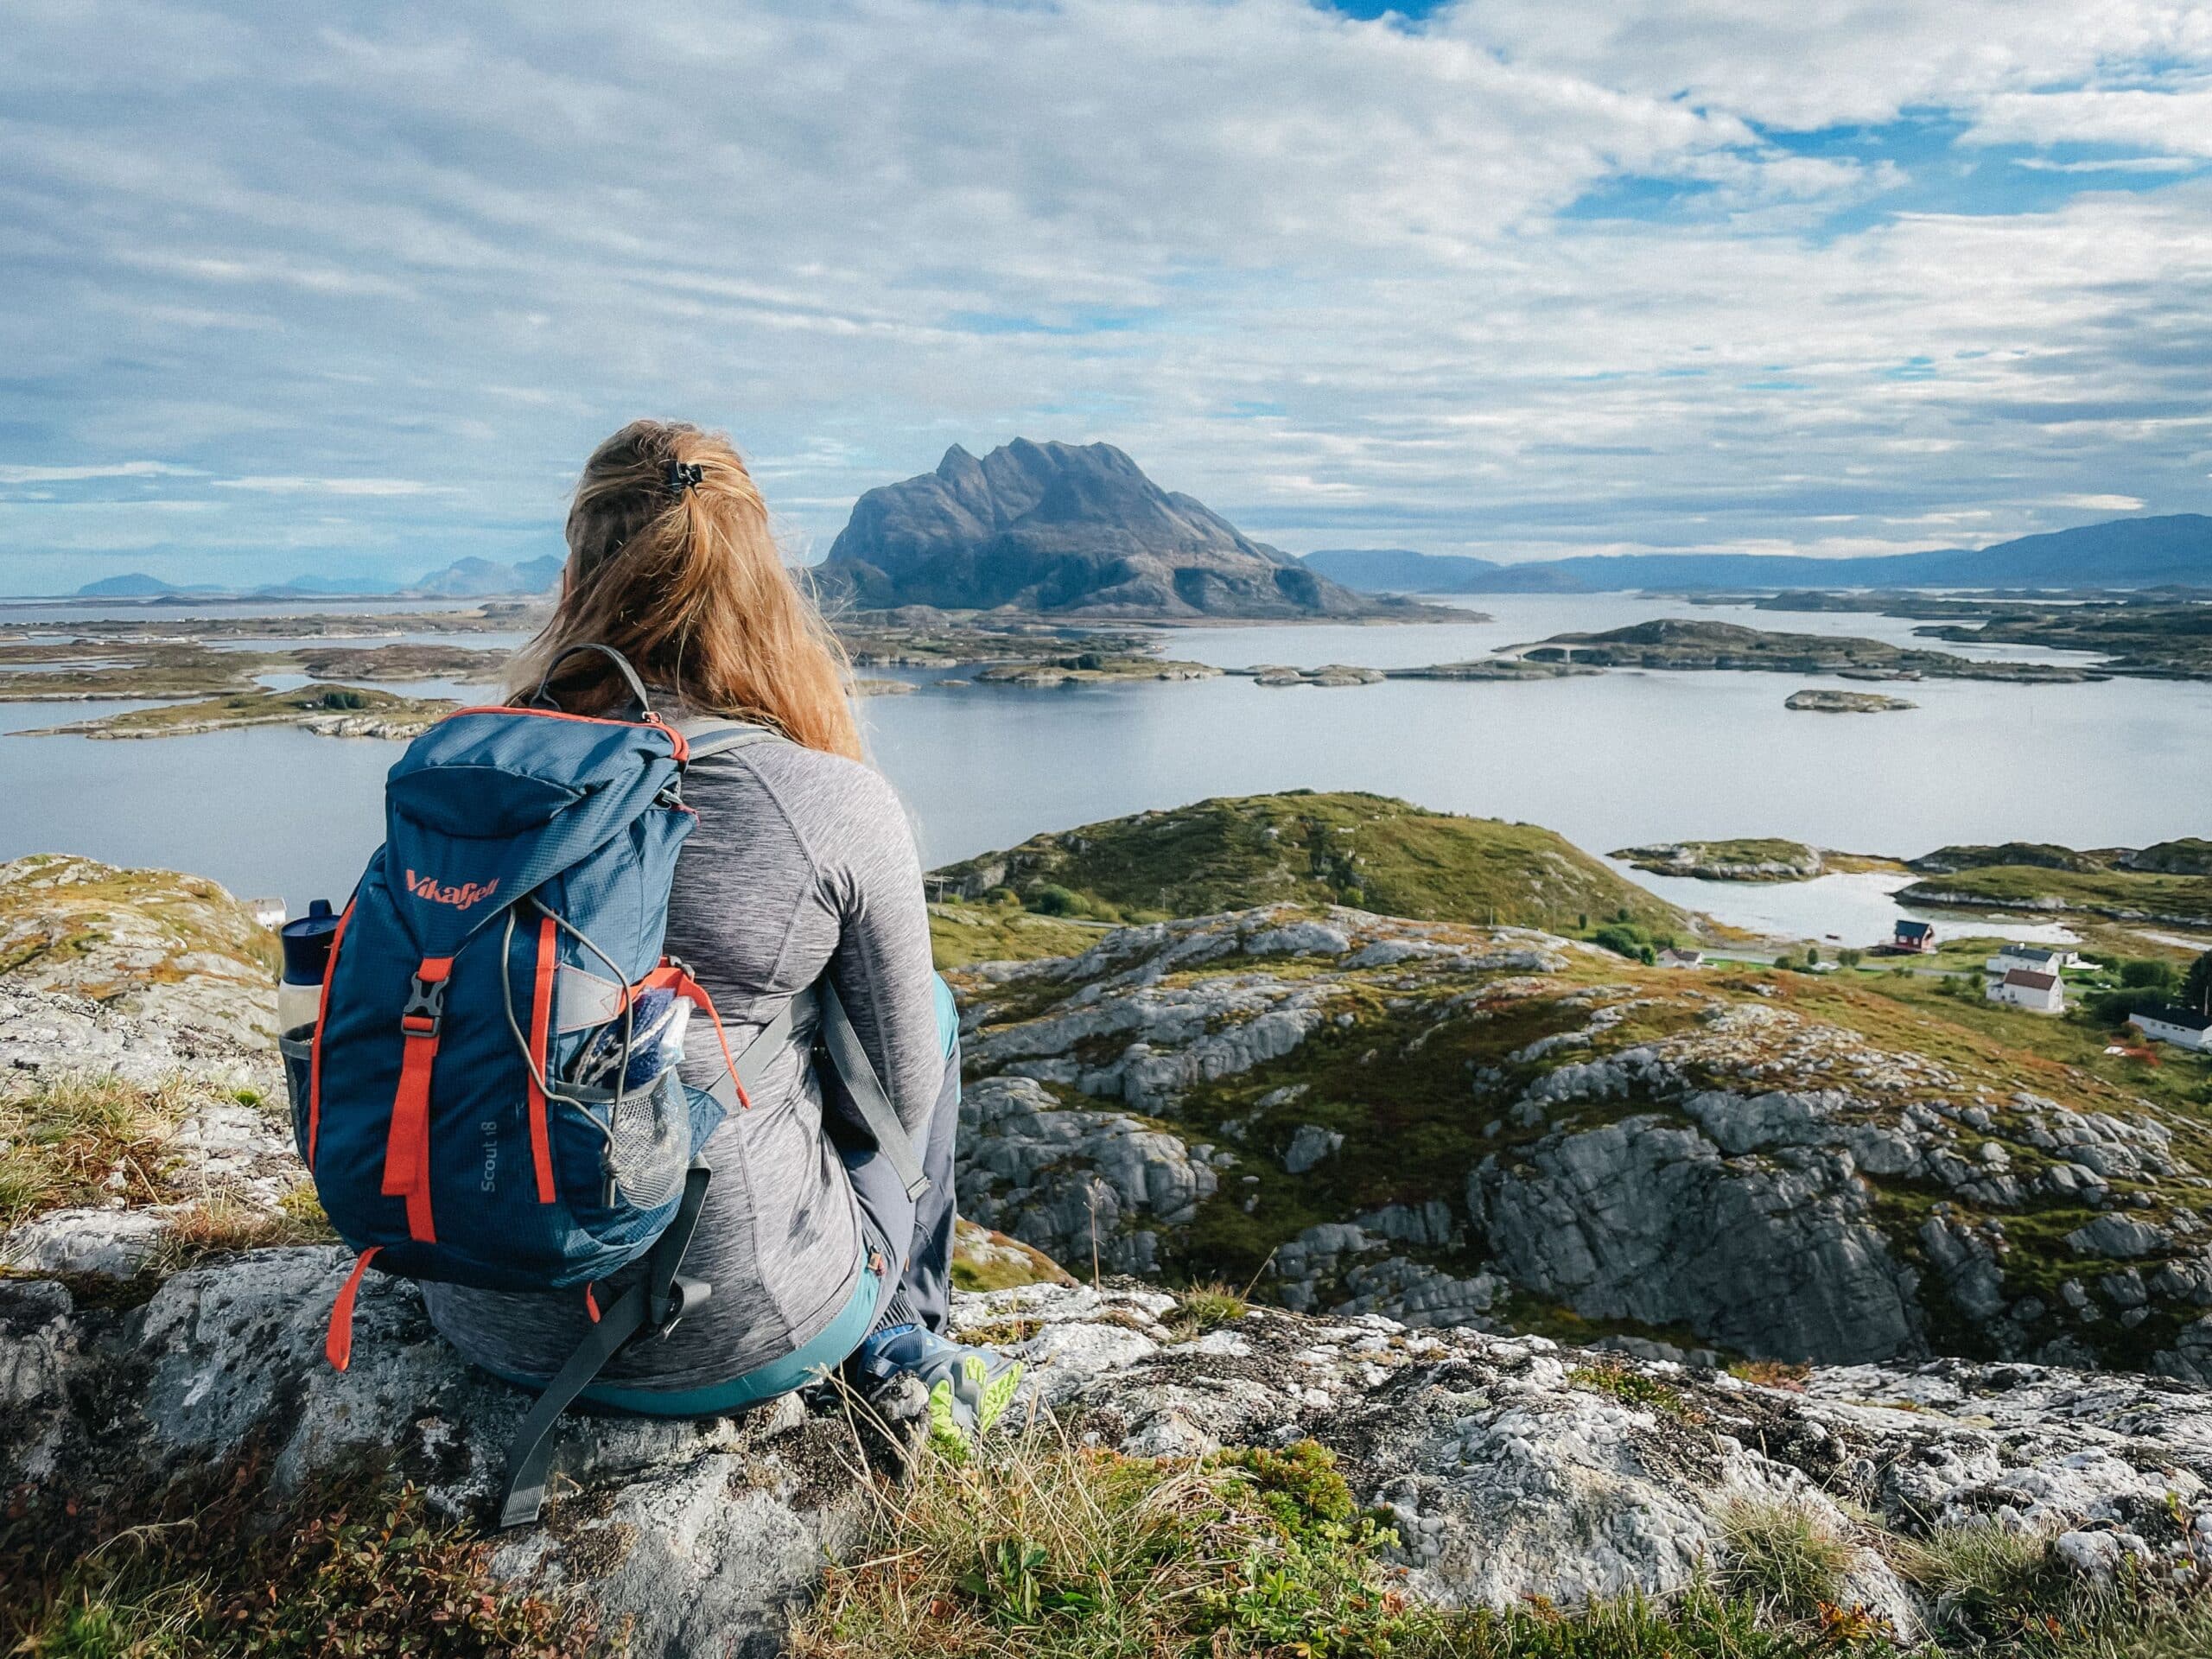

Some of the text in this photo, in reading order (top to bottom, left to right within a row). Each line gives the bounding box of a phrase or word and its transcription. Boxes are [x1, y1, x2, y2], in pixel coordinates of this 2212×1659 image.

[405, 868, 500, 910] Vikafjell
[481, 1121, 497, 1192] Scout 18
